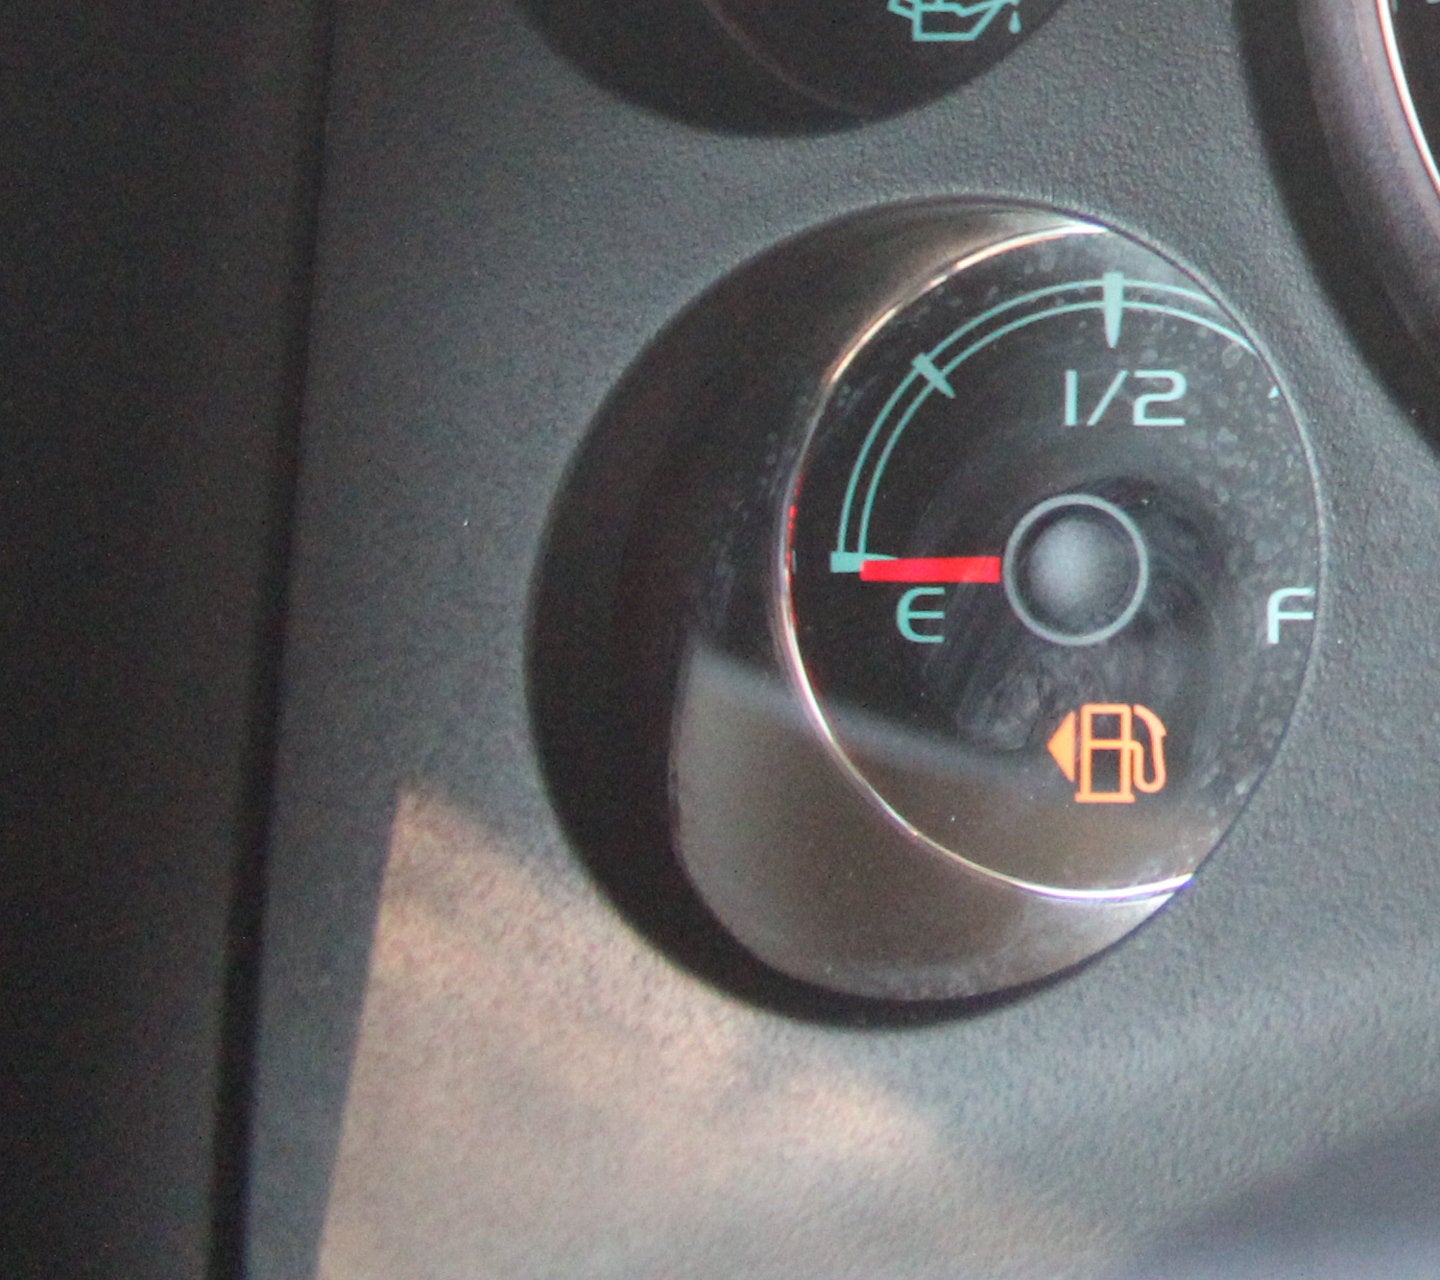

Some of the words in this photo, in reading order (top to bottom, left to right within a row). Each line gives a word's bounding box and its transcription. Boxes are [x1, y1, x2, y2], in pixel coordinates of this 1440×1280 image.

[1065, 370, 1187, 426] 1/2
[897, 587, 945, 643] E
[1267, 587, 1314, 644] F
